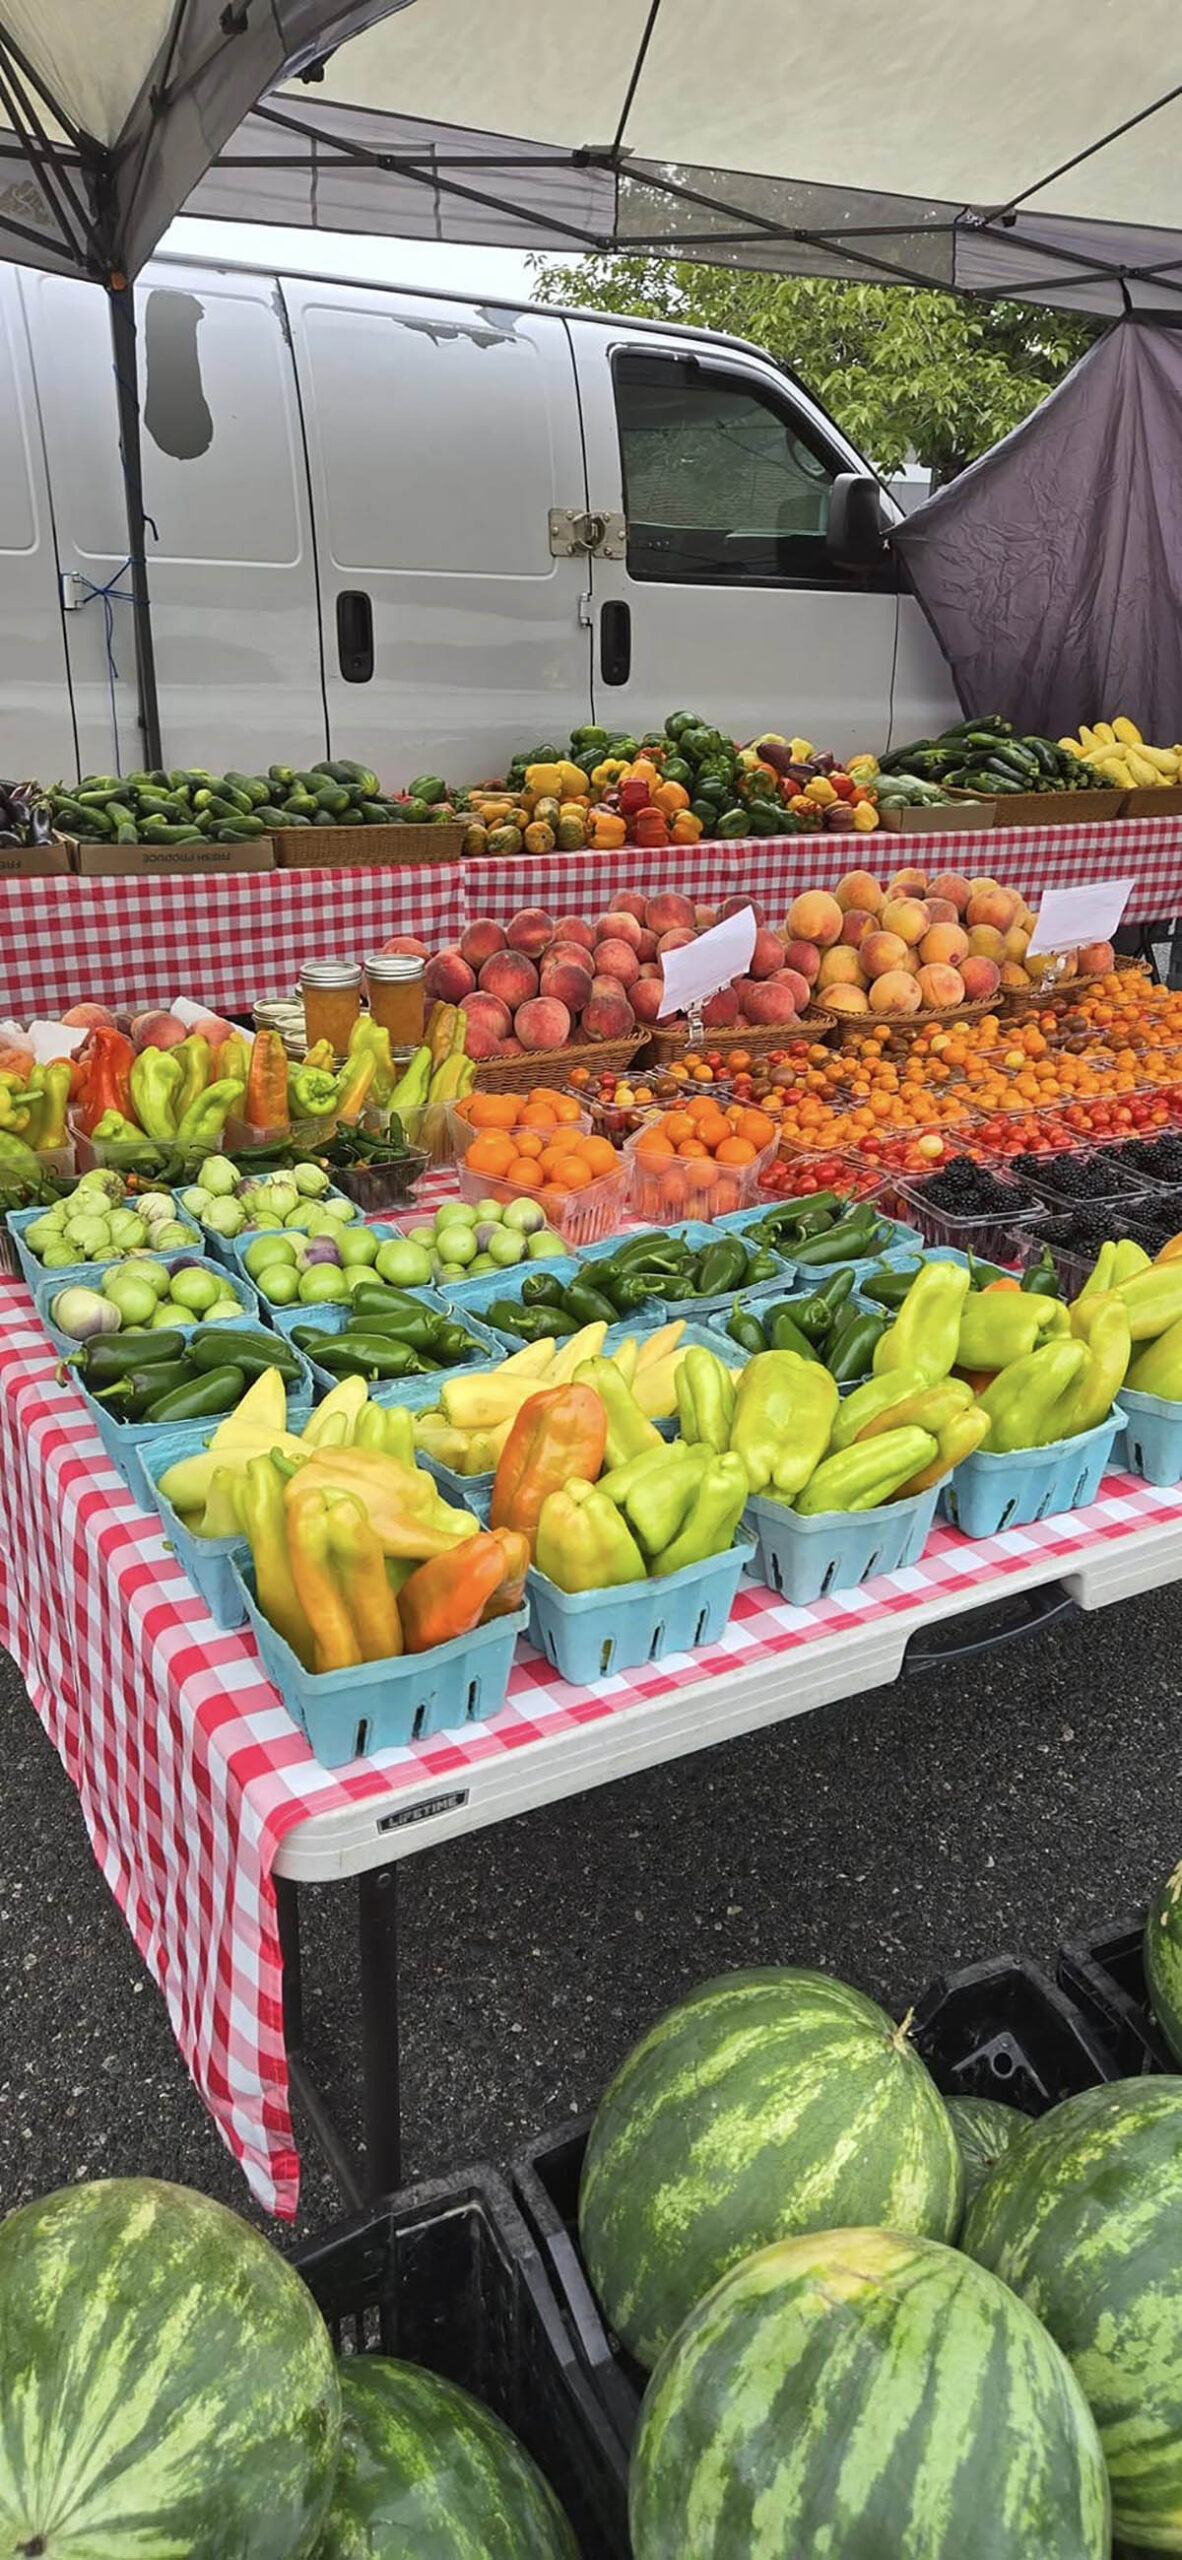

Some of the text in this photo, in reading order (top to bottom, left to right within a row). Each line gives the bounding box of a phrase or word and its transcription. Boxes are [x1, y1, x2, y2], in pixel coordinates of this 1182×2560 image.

[142, 851, 232, 863] FRESH PRODUCE
[388, 1796, 459, 1825] LIFETIME
